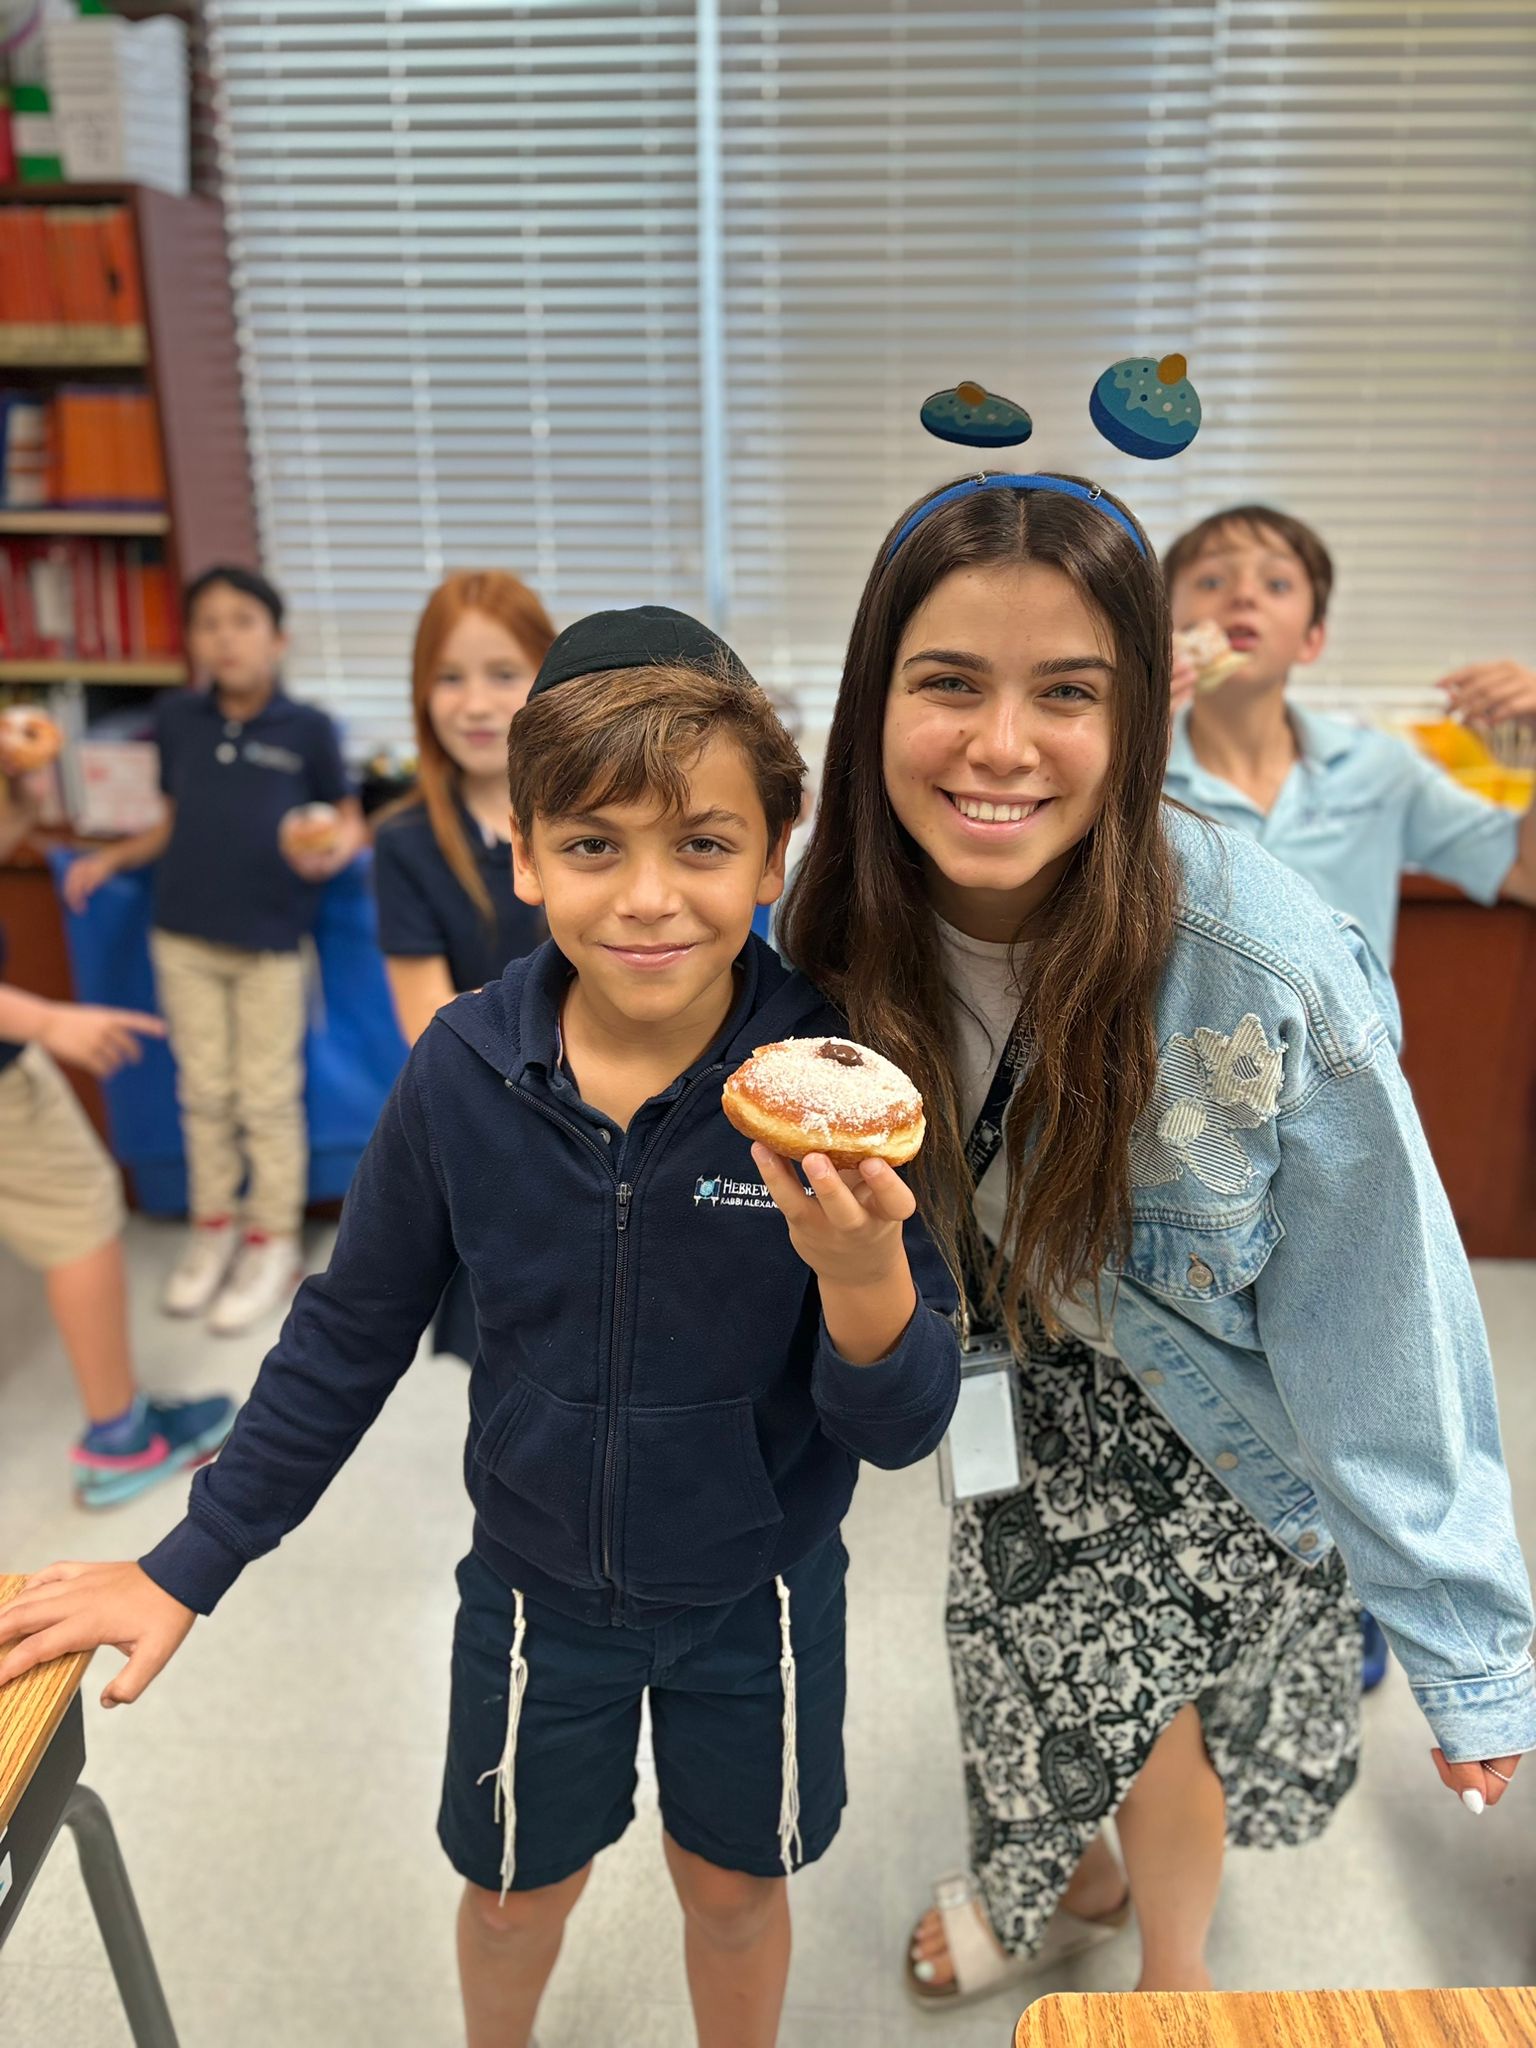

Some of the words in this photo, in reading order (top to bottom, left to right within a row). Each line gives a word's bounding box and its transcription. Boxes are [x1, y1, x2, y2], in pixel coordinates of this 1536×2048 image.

[723, 1178, 769, 1196] HEBREW
[720, 1198, 742, 1206] RABBI
[744, 1199, 779, 1208] ALEXAN
